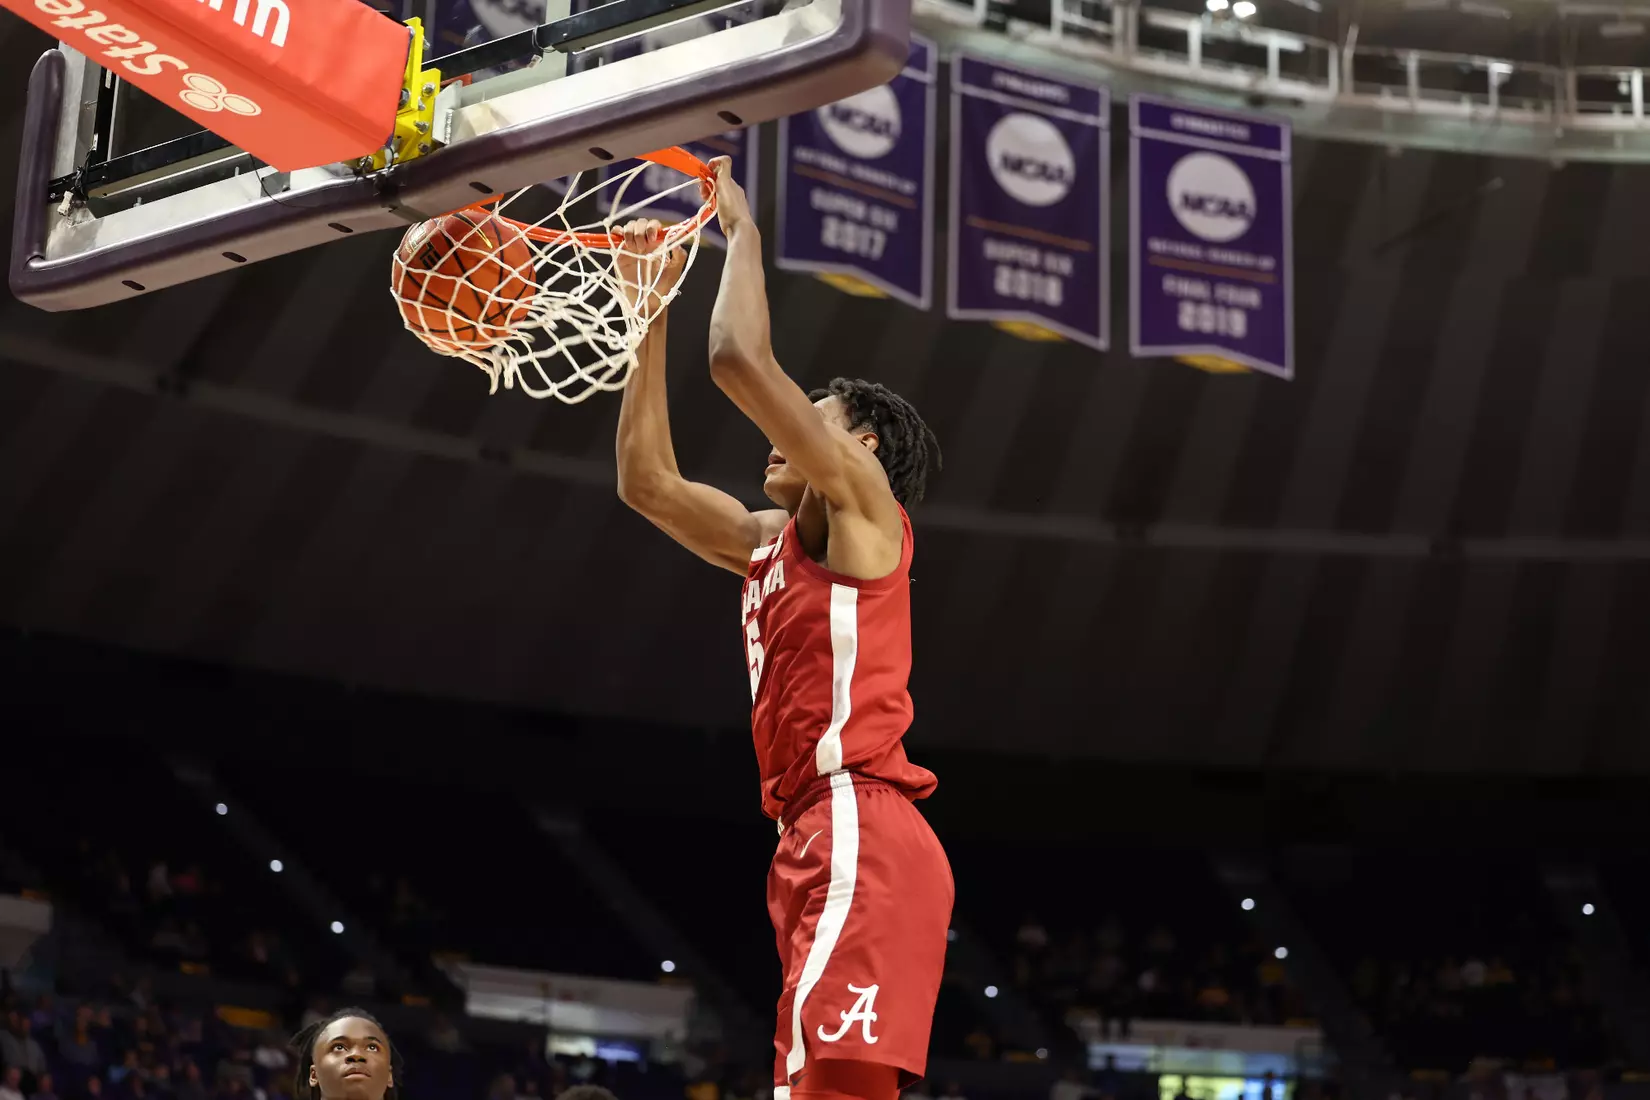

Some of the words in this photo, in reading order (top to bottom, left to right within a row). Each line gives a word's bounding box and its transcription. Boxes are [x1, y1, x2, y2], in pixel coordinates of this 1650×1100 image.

[34, 0, 189, 75] State
[1001, 150, 1072, 184] NCAA
[1181, 189, 1254, 219] NCAA
[820, 215, 888, 261] 2017
[817, 983, 880, 1044] A
